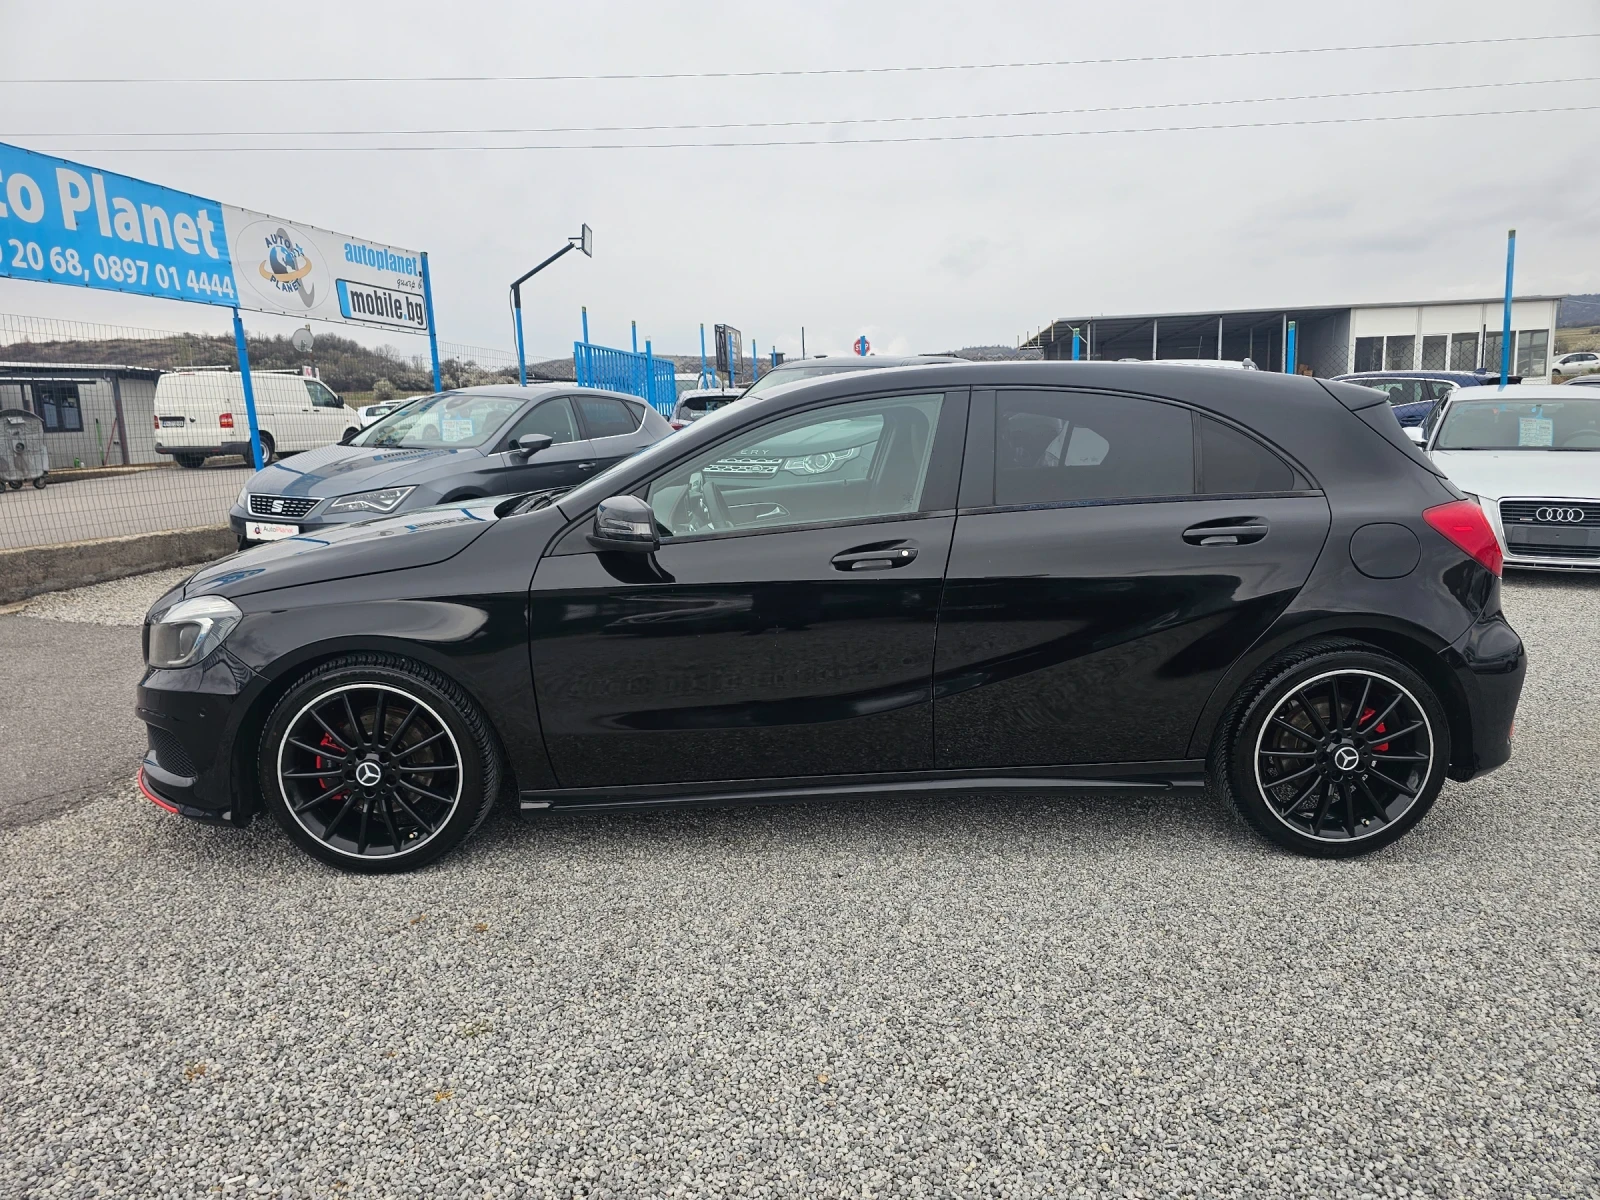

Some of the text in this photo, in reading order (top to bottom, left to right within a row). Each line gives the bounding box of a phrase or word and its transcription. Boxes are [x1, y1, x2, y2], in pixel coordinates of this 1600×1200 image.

[55, 167, 220, 260] Planet
[265, 233, 291, 249] AUTO
[8, 238, 44, 271] 20
[93, 252, 149, 286] 0897
[155, 263, 181, 291] 01
[186, 269, 234, 299] 4444
[270, 274, 301, 293] PLANET
[350, 289, 424, 326] mobile.bg
